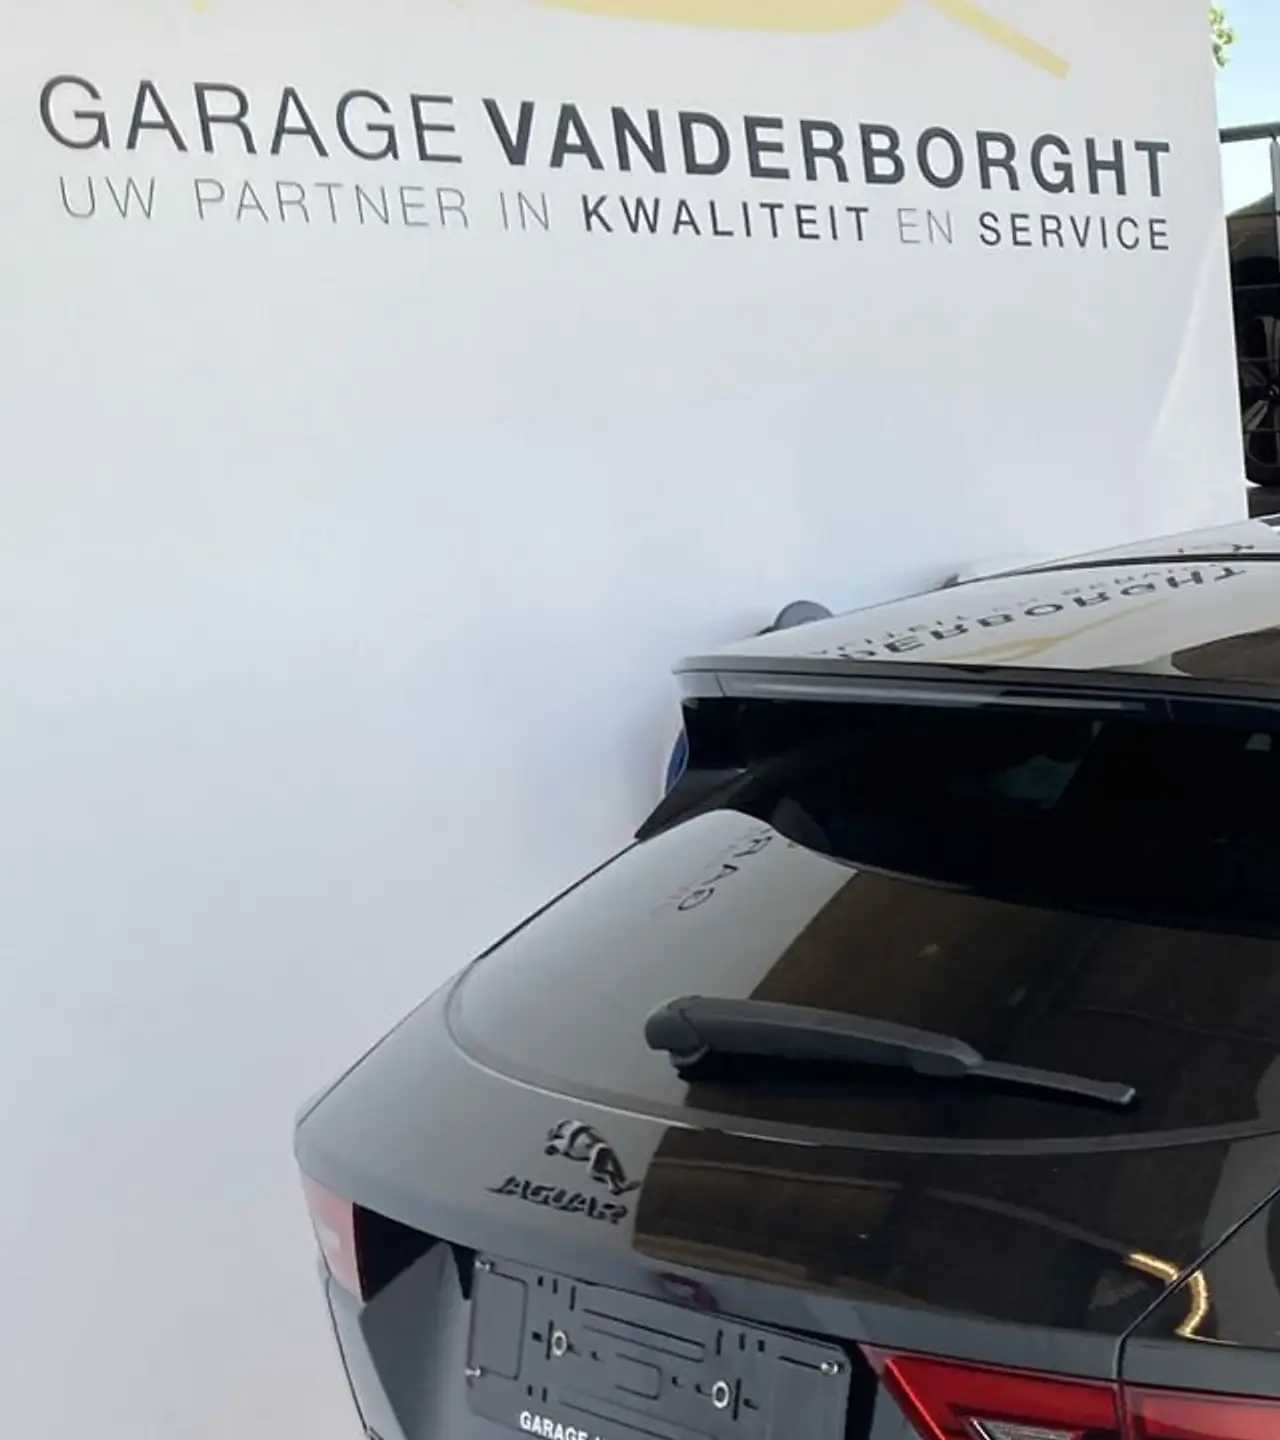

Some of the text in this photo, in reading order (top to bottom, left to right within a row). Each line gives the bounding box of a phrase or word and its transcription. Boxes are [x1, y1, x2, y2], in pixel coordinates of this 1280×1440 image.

[39, 74, 1171, 198] GARAGE VANDERBORGHT
[59, 175, 1170, 251] UW PARTNER IN KWALITEIT EN SERVICE
[486, 1175, 629, 1225] JAGUAR
